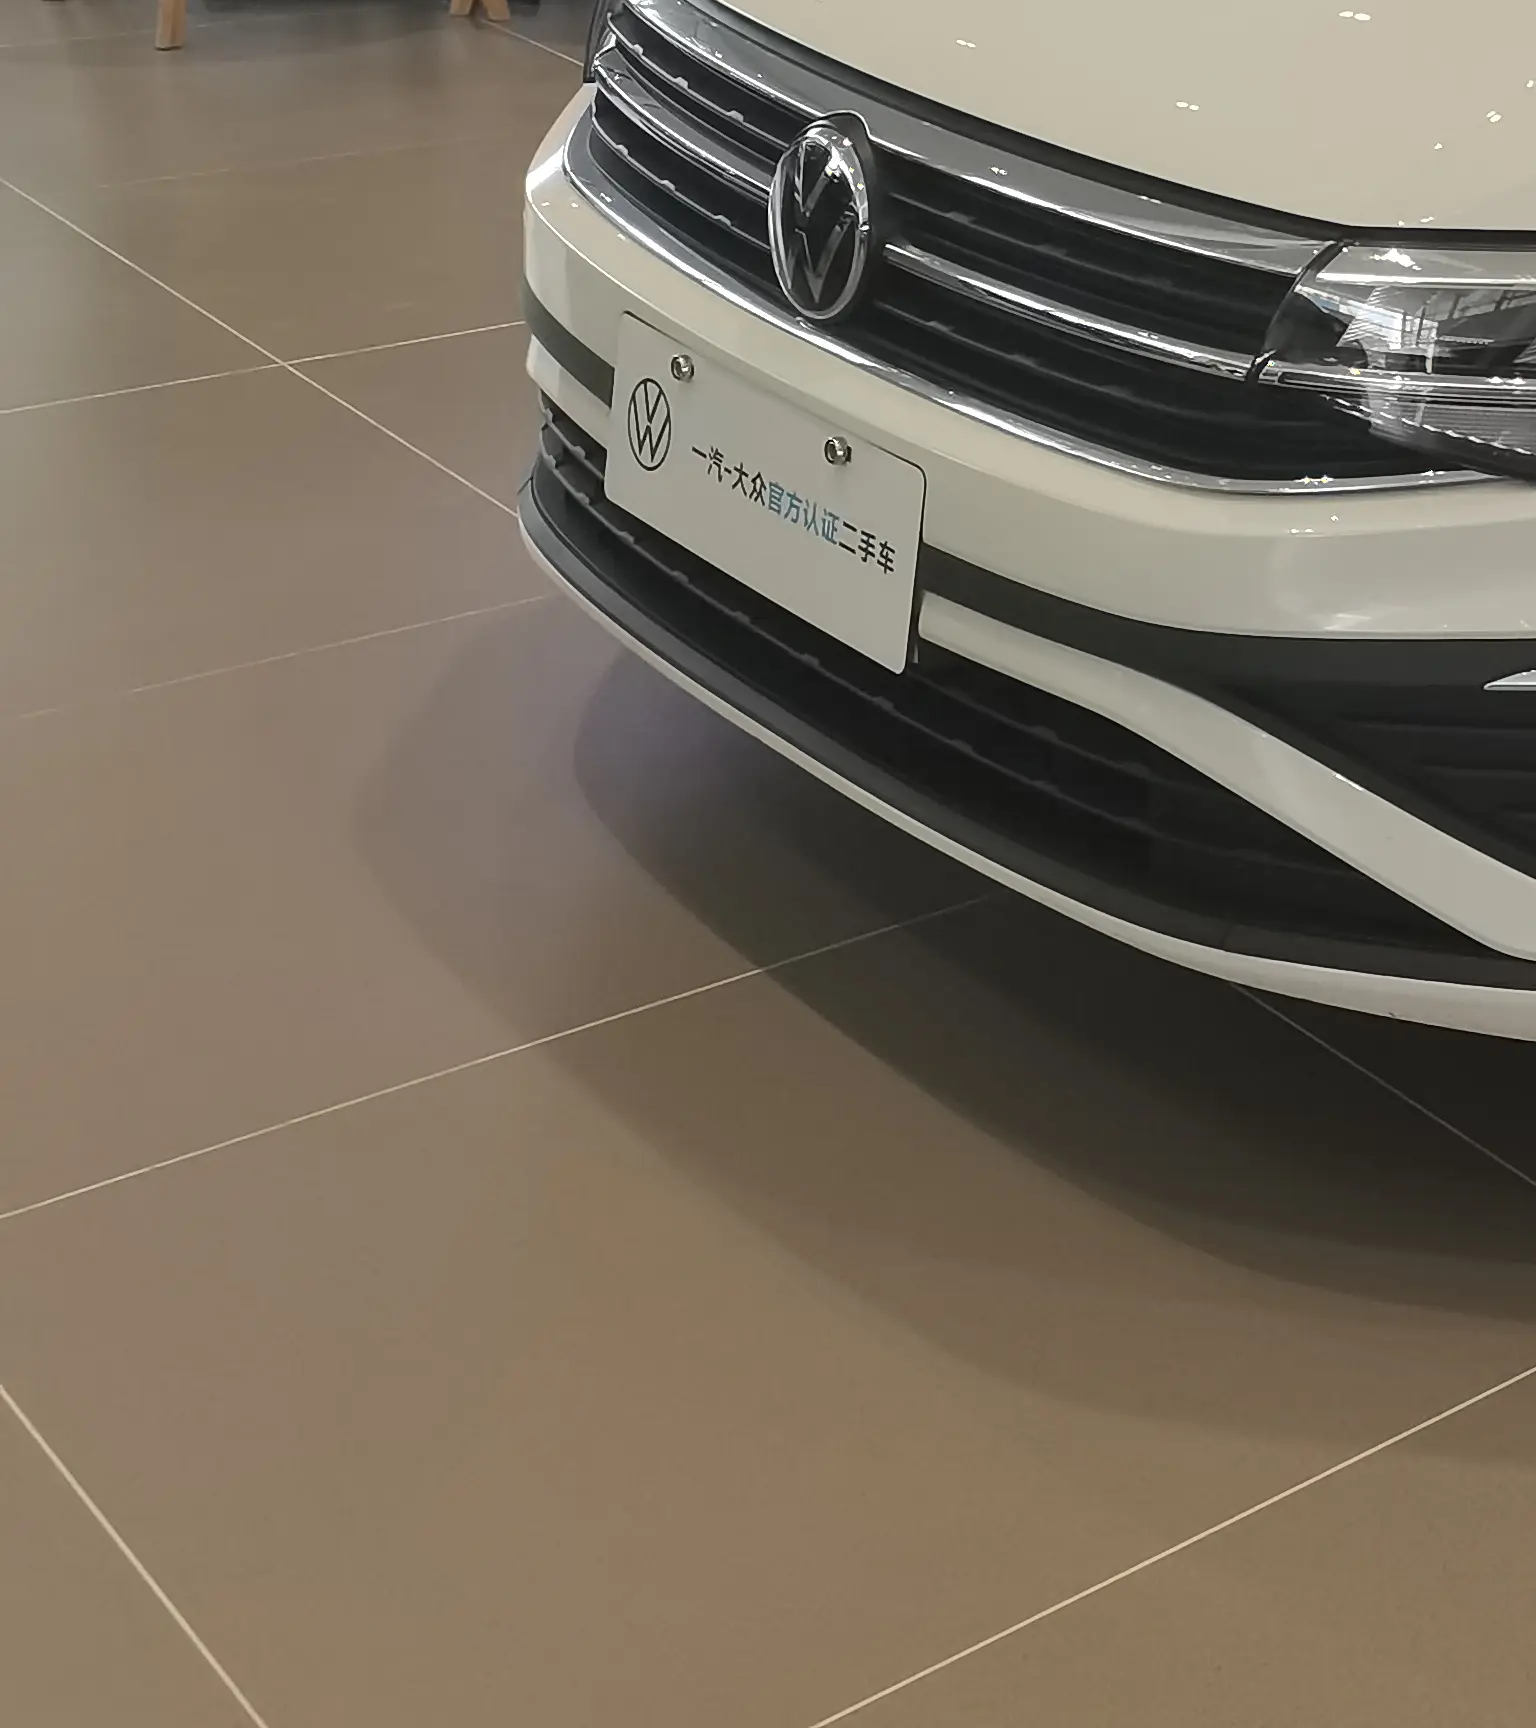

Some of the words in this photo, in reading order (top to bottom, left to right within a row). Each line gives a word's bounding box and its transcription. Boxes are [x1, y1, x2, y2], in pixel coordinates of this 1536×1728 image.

[691, 443, 896, 575] 一汽-大众官方认证二手车
